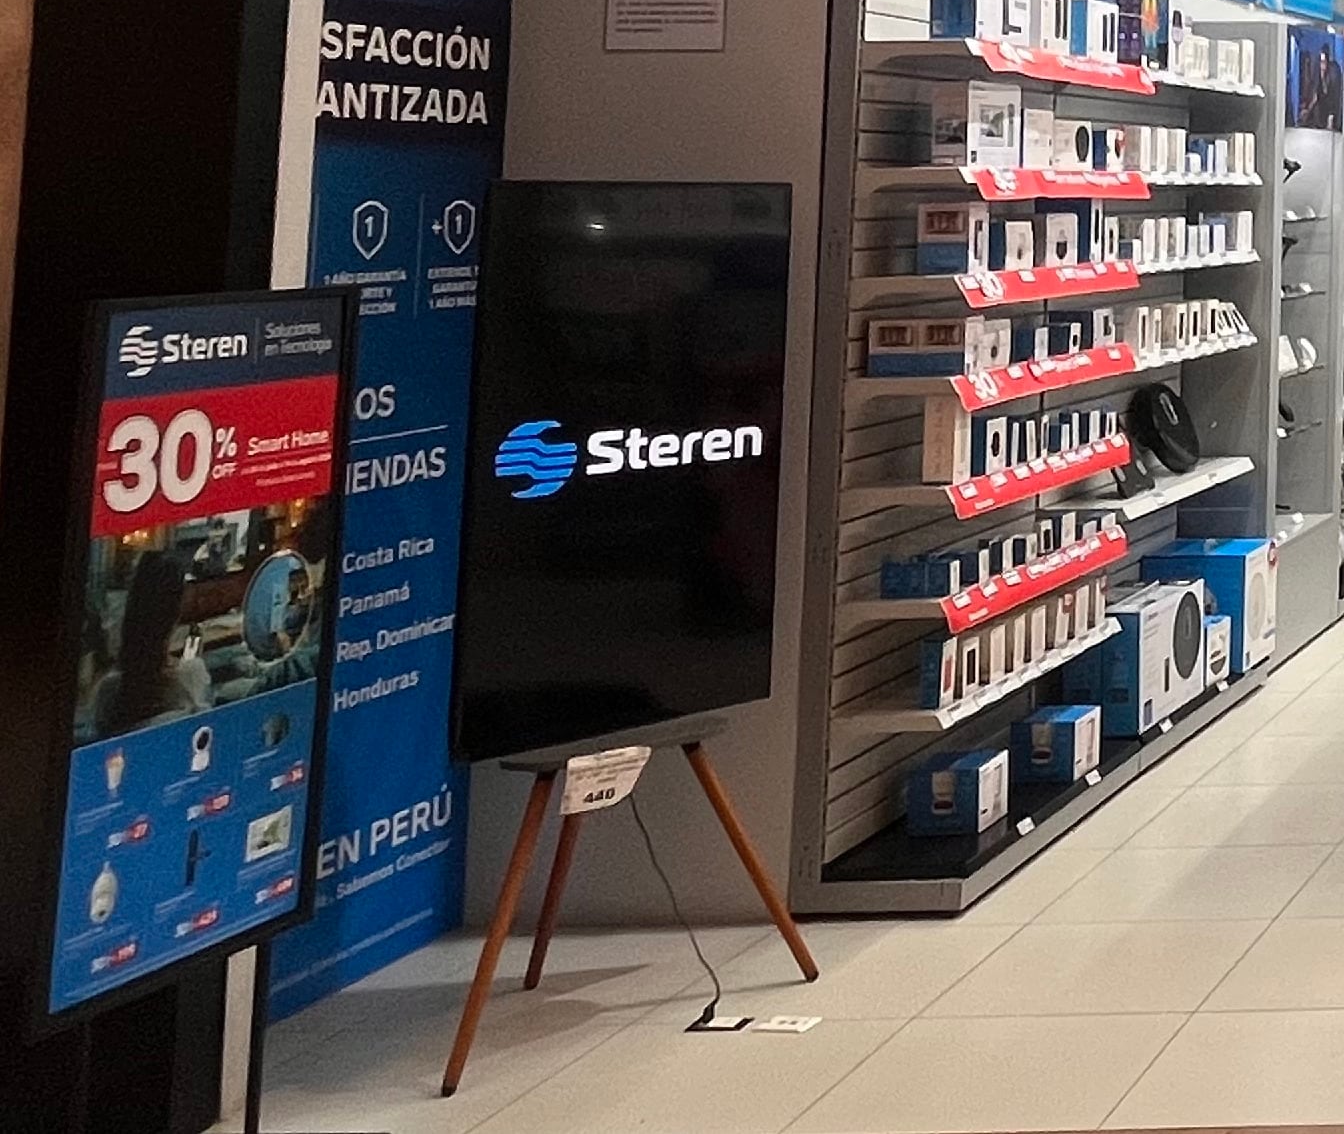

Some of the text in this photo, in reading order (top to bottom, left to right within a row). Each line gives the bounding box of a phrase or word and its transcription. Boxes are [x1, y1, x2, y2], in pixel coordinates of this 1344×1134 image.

[320, 20, 491, 71] SFACCIÓN
[160, 331, 249, 364] Steren
[246, 428, 330, 456] Smart Home
[585, 425, 764, 476] Steren
[211, 462, 239, 480] OFF
[341, 535, 435, 575] Costa Rica
[338, 580, 411, 618] Panamá
[333, 669, 420, 713] Honduras
[315, 782, 453, 880] EN PERÚ
